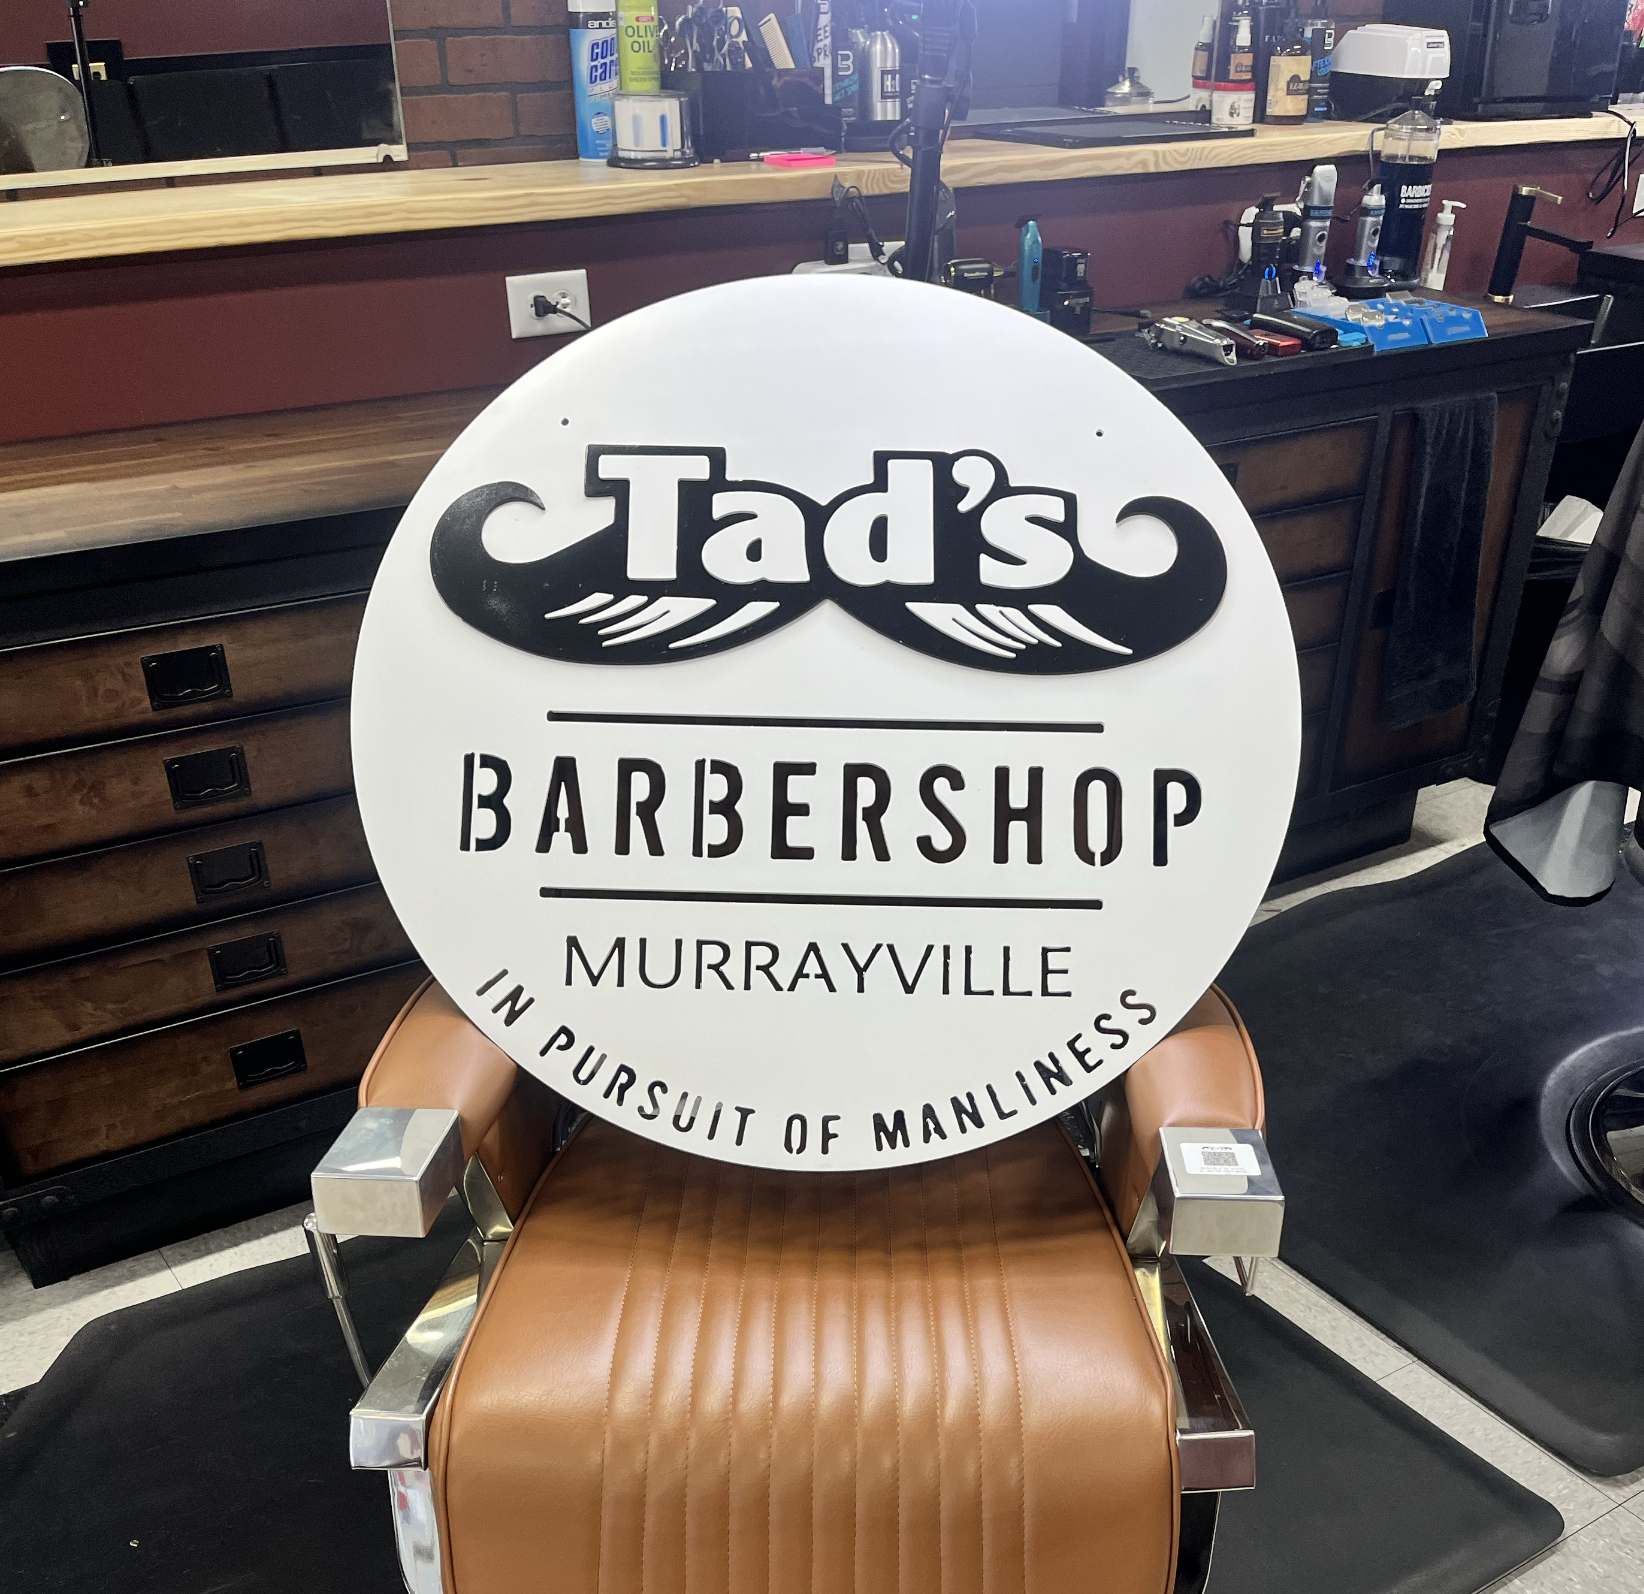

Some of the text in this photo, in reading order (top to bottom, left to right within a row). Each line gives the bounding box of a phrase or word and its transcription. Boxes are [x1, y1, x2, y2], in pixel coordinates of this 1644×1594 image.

[590, 36, 616, 63] coo
[630, 40, 654, 53] OIL
[598, 454, 1075, 589] Tad's
[459, 751, 1202, 868] BARBERSHOP
[564, 935, 1073, 998] MURRAYVILLE
[475, 968, 1157, 1155] IN PURSUIT OF MANLINESS
